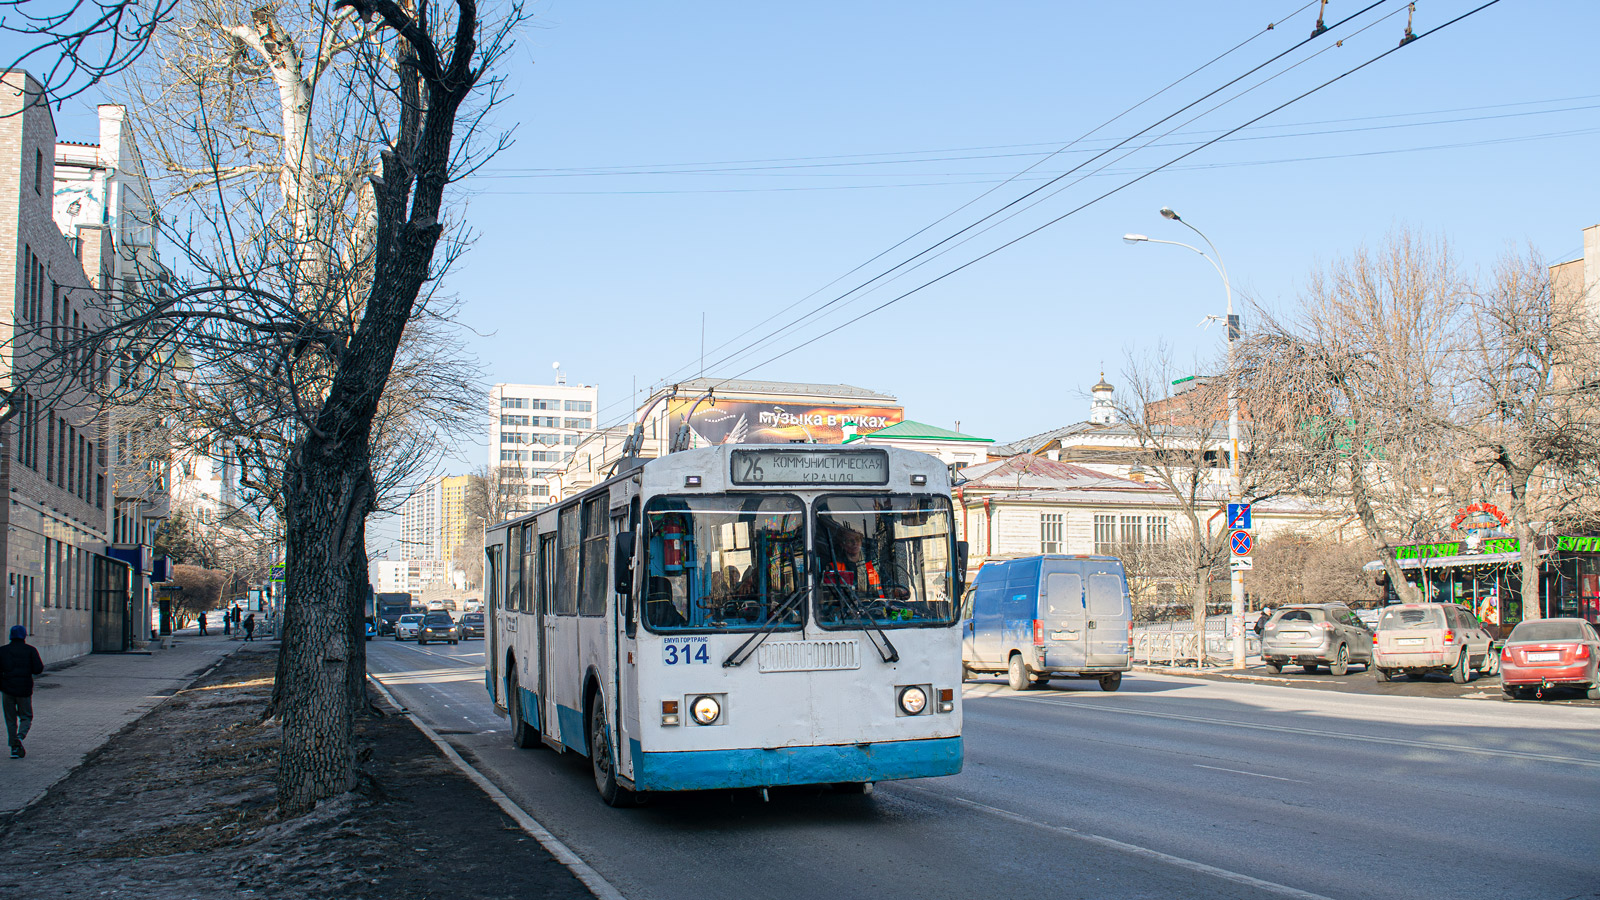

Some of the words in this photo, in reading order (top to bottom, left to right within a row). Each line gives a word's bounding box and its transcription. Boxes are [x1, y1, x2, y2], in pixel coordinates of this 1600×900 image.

[742, 456, 764, 482] 26
[773, 456, 883, 470] КОММУНИСТИЧЕСКАЯ
[1483, 538, 1521, 554] КЕБА
[664, 643, 709, 665] 314
